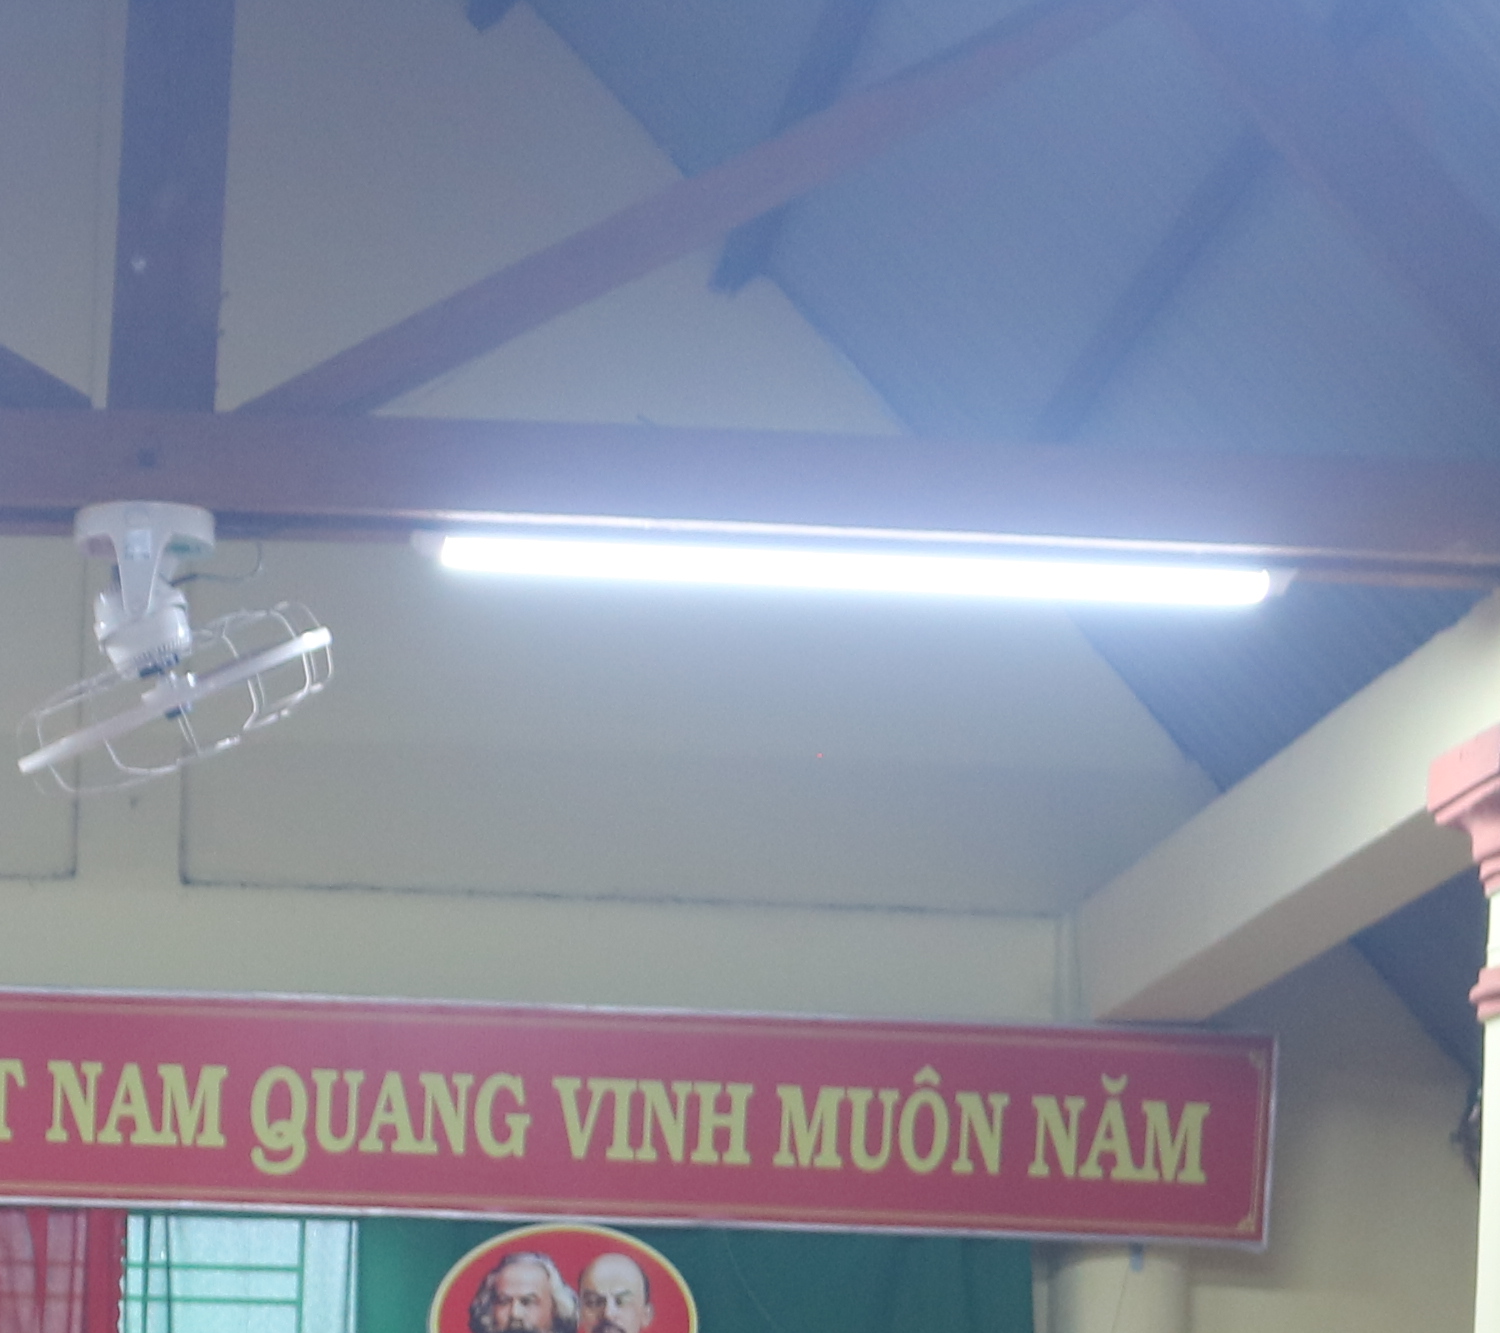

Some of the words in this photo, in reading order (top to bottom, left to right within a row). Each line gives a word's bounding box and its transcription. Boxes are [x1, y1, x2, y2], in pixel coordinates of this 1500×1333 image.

[45, 1061, 228, 1149] NAM
[248, 1064, 532, 1175] QUANG
[552, 1075, 754, 1167] VINH
[773, 1065, 1010, 1177] MUÔN
[1027, 1072, 1211, 1186] NĂM
